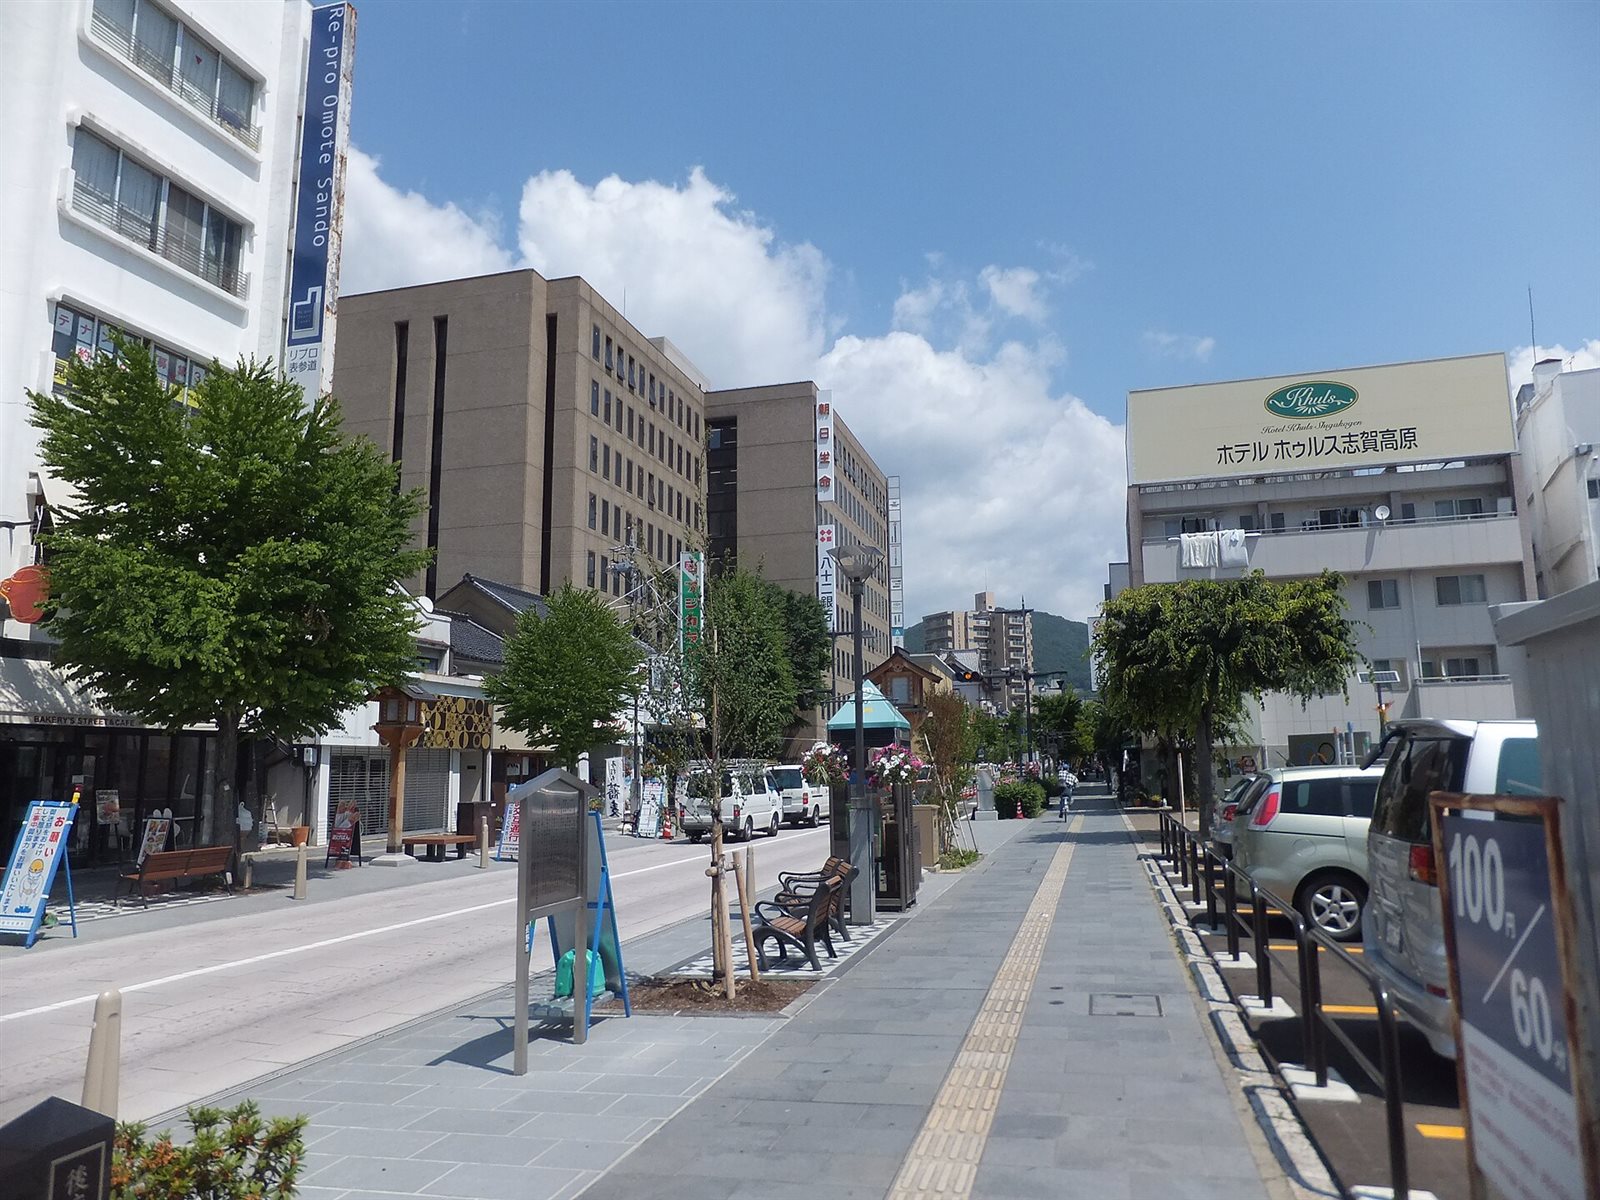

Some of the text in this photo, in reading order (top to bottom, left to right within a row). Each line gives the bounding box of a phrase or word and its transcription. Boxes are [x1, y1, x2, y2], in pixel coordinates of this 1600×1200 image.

[313, 7, 345, 247] Re-pro Omote Sando
[290, 360, 318, 374] 表参道
[1276, 386, 1346, 409] Khuls
[1261, 425, 1285, 434] Hotel
[819, 403, 831, 488] 朝日生命
[1216, 427, 1419, 465] ホテル ホゥルス志賀高原
[34, 715, 75, 725] BAKERY'S
[44, 816, 65, 857] お願い
